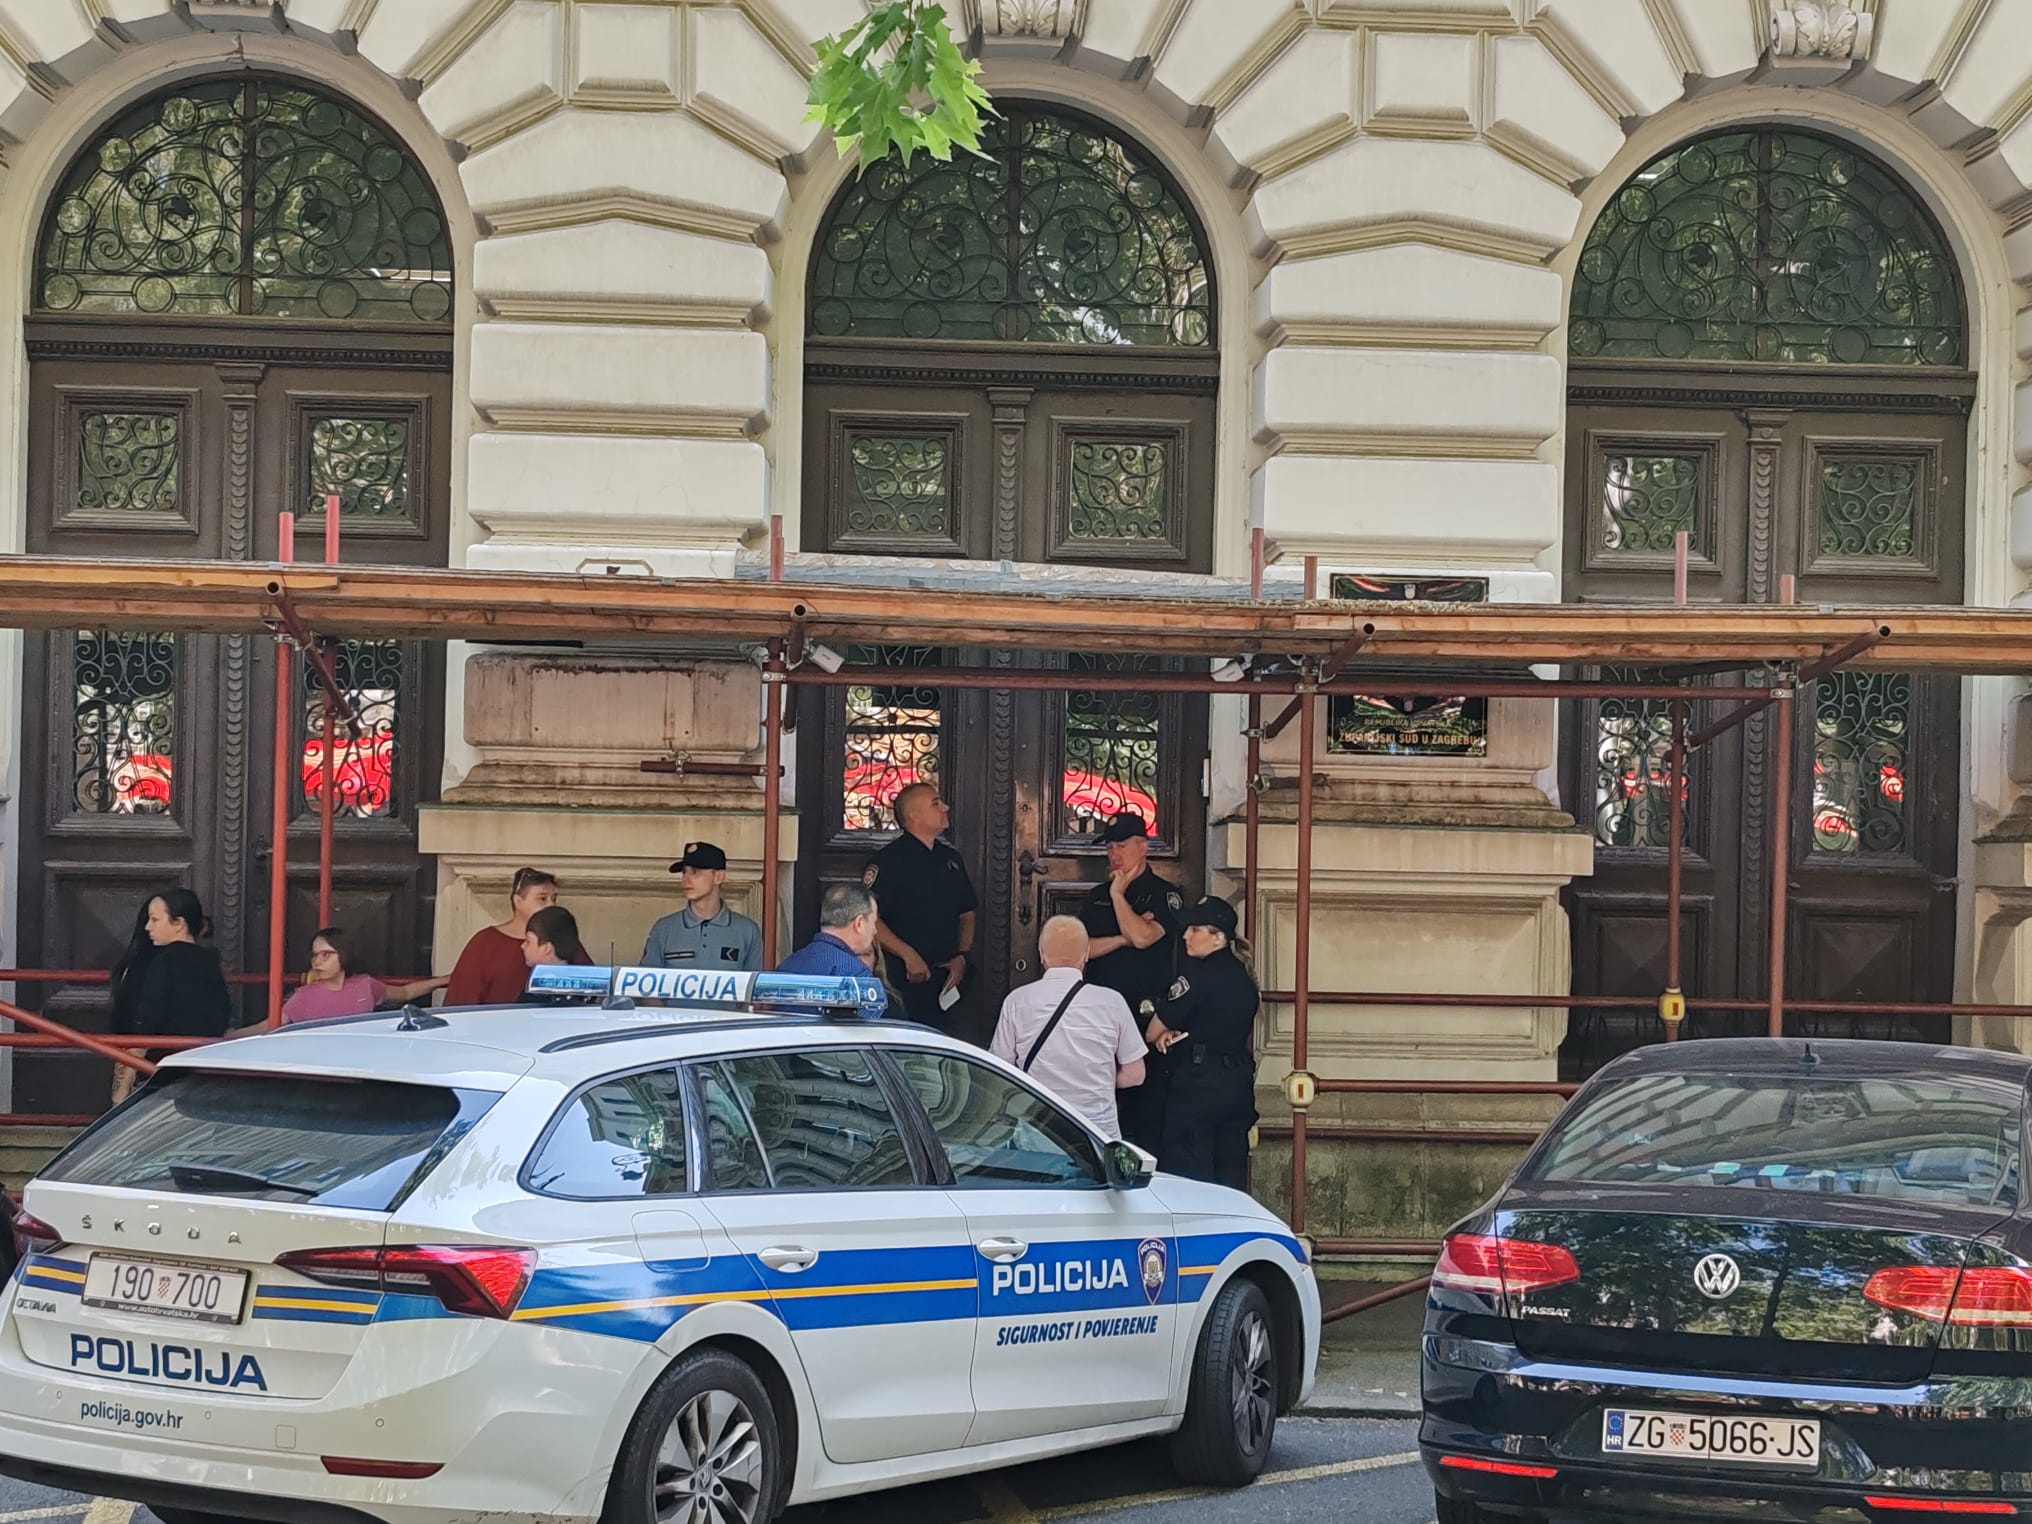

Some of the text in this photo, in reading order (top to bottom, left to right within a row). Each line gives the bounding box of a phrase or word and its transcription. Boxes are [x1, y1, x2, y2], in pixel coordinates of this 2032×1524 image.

[1399, 732, 1419, 744] SUD
[1422, 733, 1429, 745] U
[1432, 733, 1476, 746] ZAGREBU
[621, 971, 738, 1001] POLICIJA
[111, 1264, 222, 1310] 190 700
[992, 1258, 1129, 1297] POLICIJA
[1521, 1305, 1571, 1318] PASSAT
[996, 1315, 1159, 1346] SIGURNOST I POVJERENJE
[70, 1333, 268, 1391] POLICIJA
[80, 1401, 184, 1429] policija.gov.hr
[1606, 1434, 1622, 1447] HR
[1627, 1415, 1665, 1449] ZG
